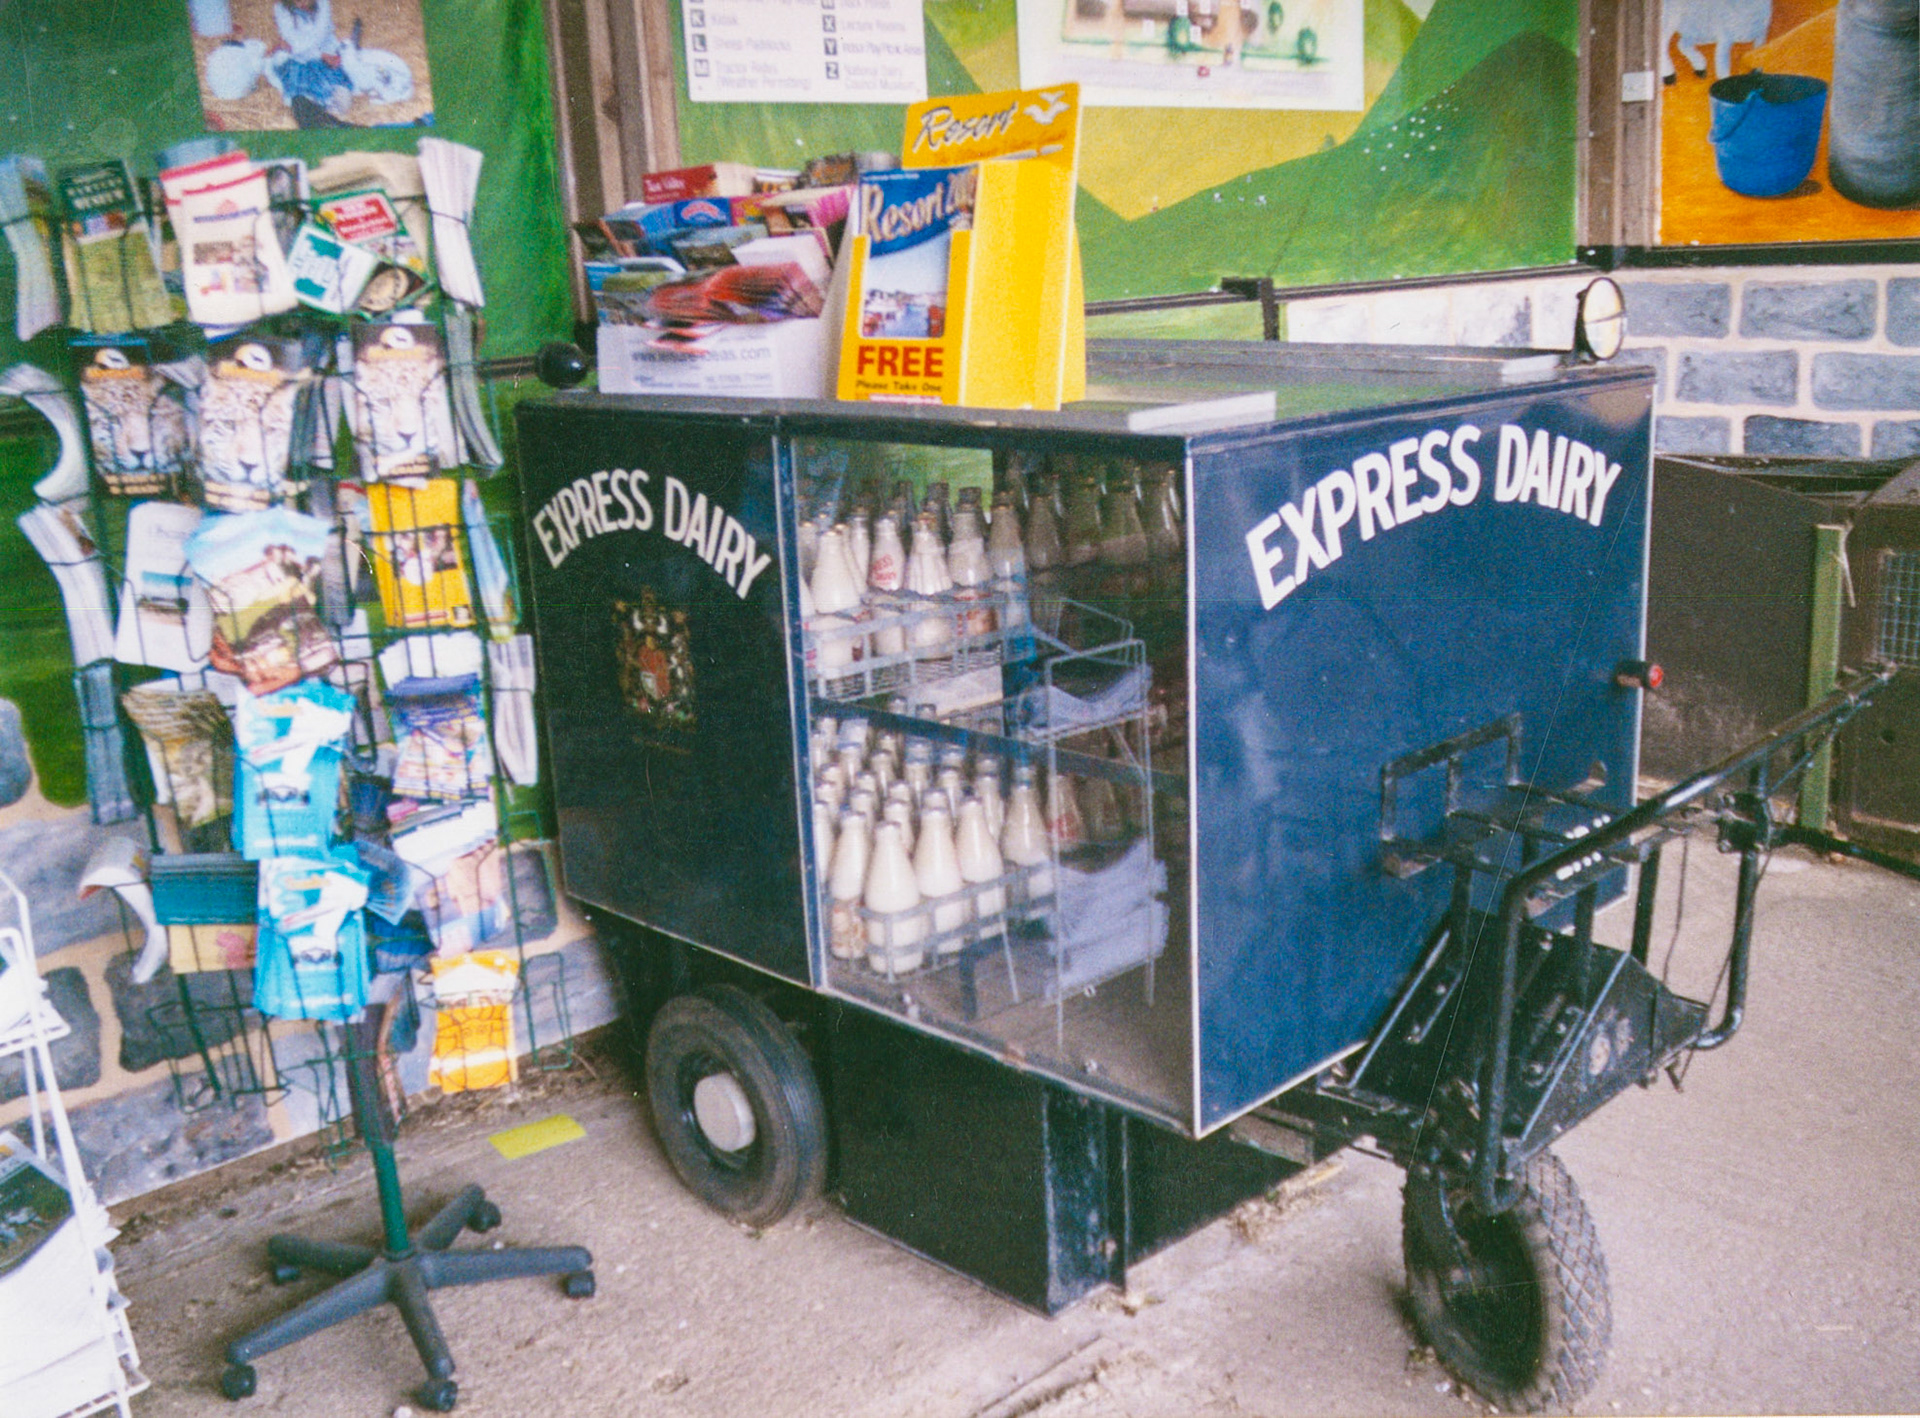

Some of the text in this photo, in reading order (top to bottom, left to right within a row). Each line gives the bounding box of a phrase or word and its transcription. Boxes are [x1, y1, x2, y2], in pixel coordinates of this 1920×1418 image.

[912, 100, 1018, 153] Resort
[860, 182, 944, 243] Resort
[856, 379, 942, 392] Please Take One
[857, 345, 943, 377] FREE
[533, 469, 771, 600] EXPRESS DAIRY
[1246, 424, 1622, 611] EXPRESS DAIRY
